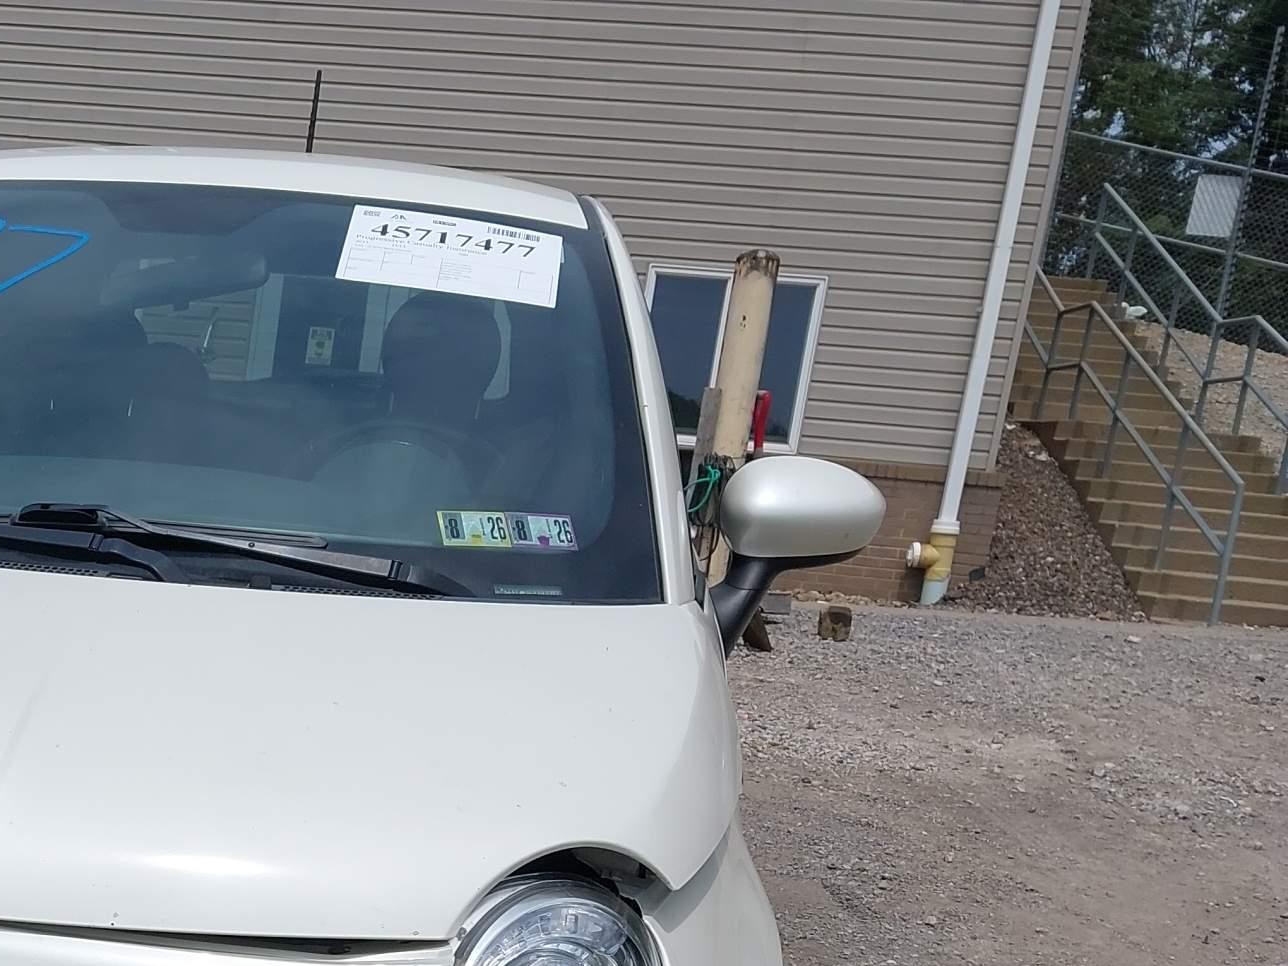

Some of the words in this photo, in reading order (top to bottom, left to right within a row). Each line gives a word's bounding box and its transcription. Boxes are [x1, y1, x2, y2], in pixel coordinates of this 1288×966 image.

[371, 223, 536, 258] 45717477
[448, 518, 460, 539] 8
[487, 516, 506, 540] 26
[515, 519, 528, 541] 8
[553, 519, 573, 543] 26
